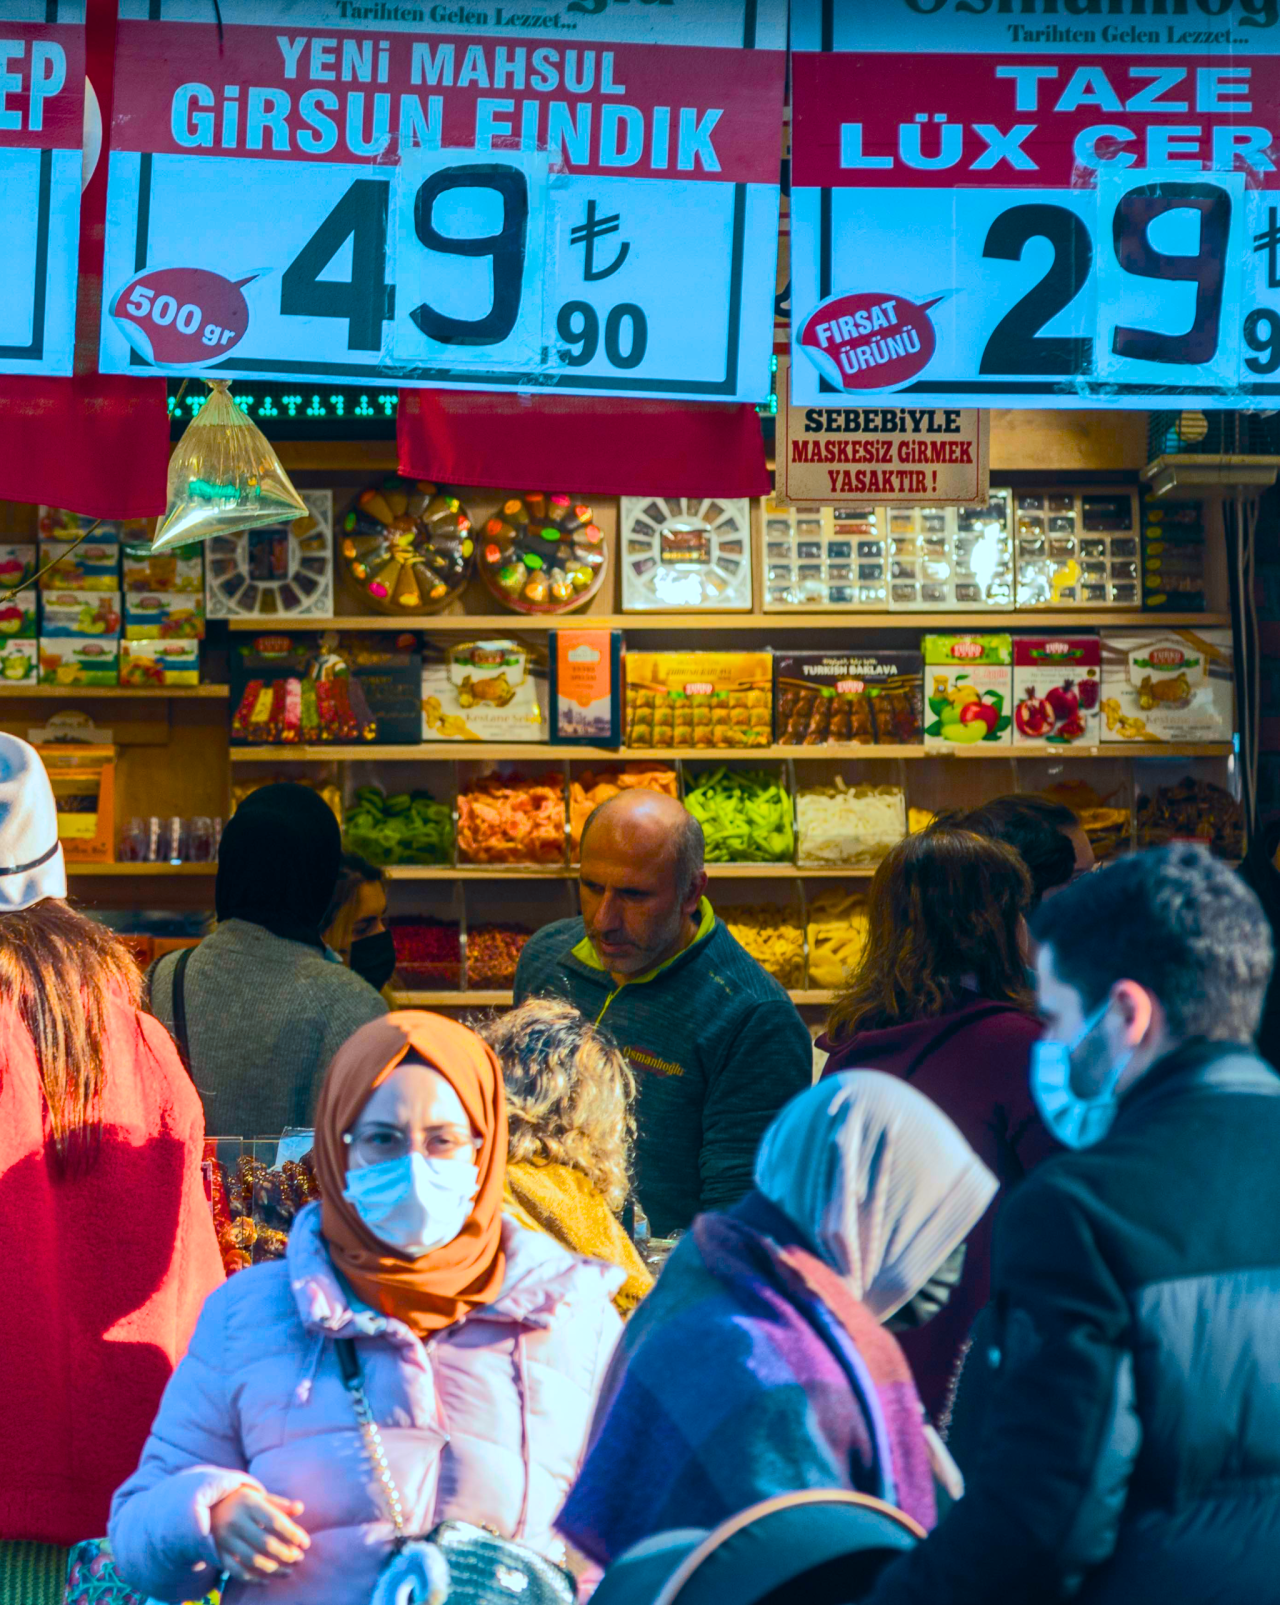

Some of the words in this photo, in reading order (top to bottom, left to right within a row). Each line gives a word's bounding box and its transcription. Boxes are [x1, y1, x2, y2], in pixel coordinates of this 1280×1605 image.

[335, 1, 424, 23] Tarihten
[430, 5, 488, 25] Gelen
[494, 8, 577, 30] Lezzet...
[1007, 24, 1096, 44] Tarihten
[1101, 25, 1160, 44] Gelen
[1166, 25, 1250, 45] Lezzet...
[410, 41, 626, 95] MAHSUL
[995, 66, 1253, 113] TAZE
[475, 96, 724, 172] FINDIK
[839, 113, 1040, 171] LÜX
[1072, 123, 1277, 172] CER
[280, 163, 529, 352] 49
[978, 182, 1233, 376] 29
[125, 282, 202, 336] 500
[200, 320, 236, 349] gr
[815, 299, 900, 349] FIRSAT
[1243, 307, 1280, 375] 9
[839, 324, 921, 376] ÜRÜNÜ
[827, 468, 928, 494] YASAKTIR
[802, 664, 847, 676] TURKISH
[849, 664, 898, 676] BAKLAVA
[466, 712, 509, 724] Kestane
